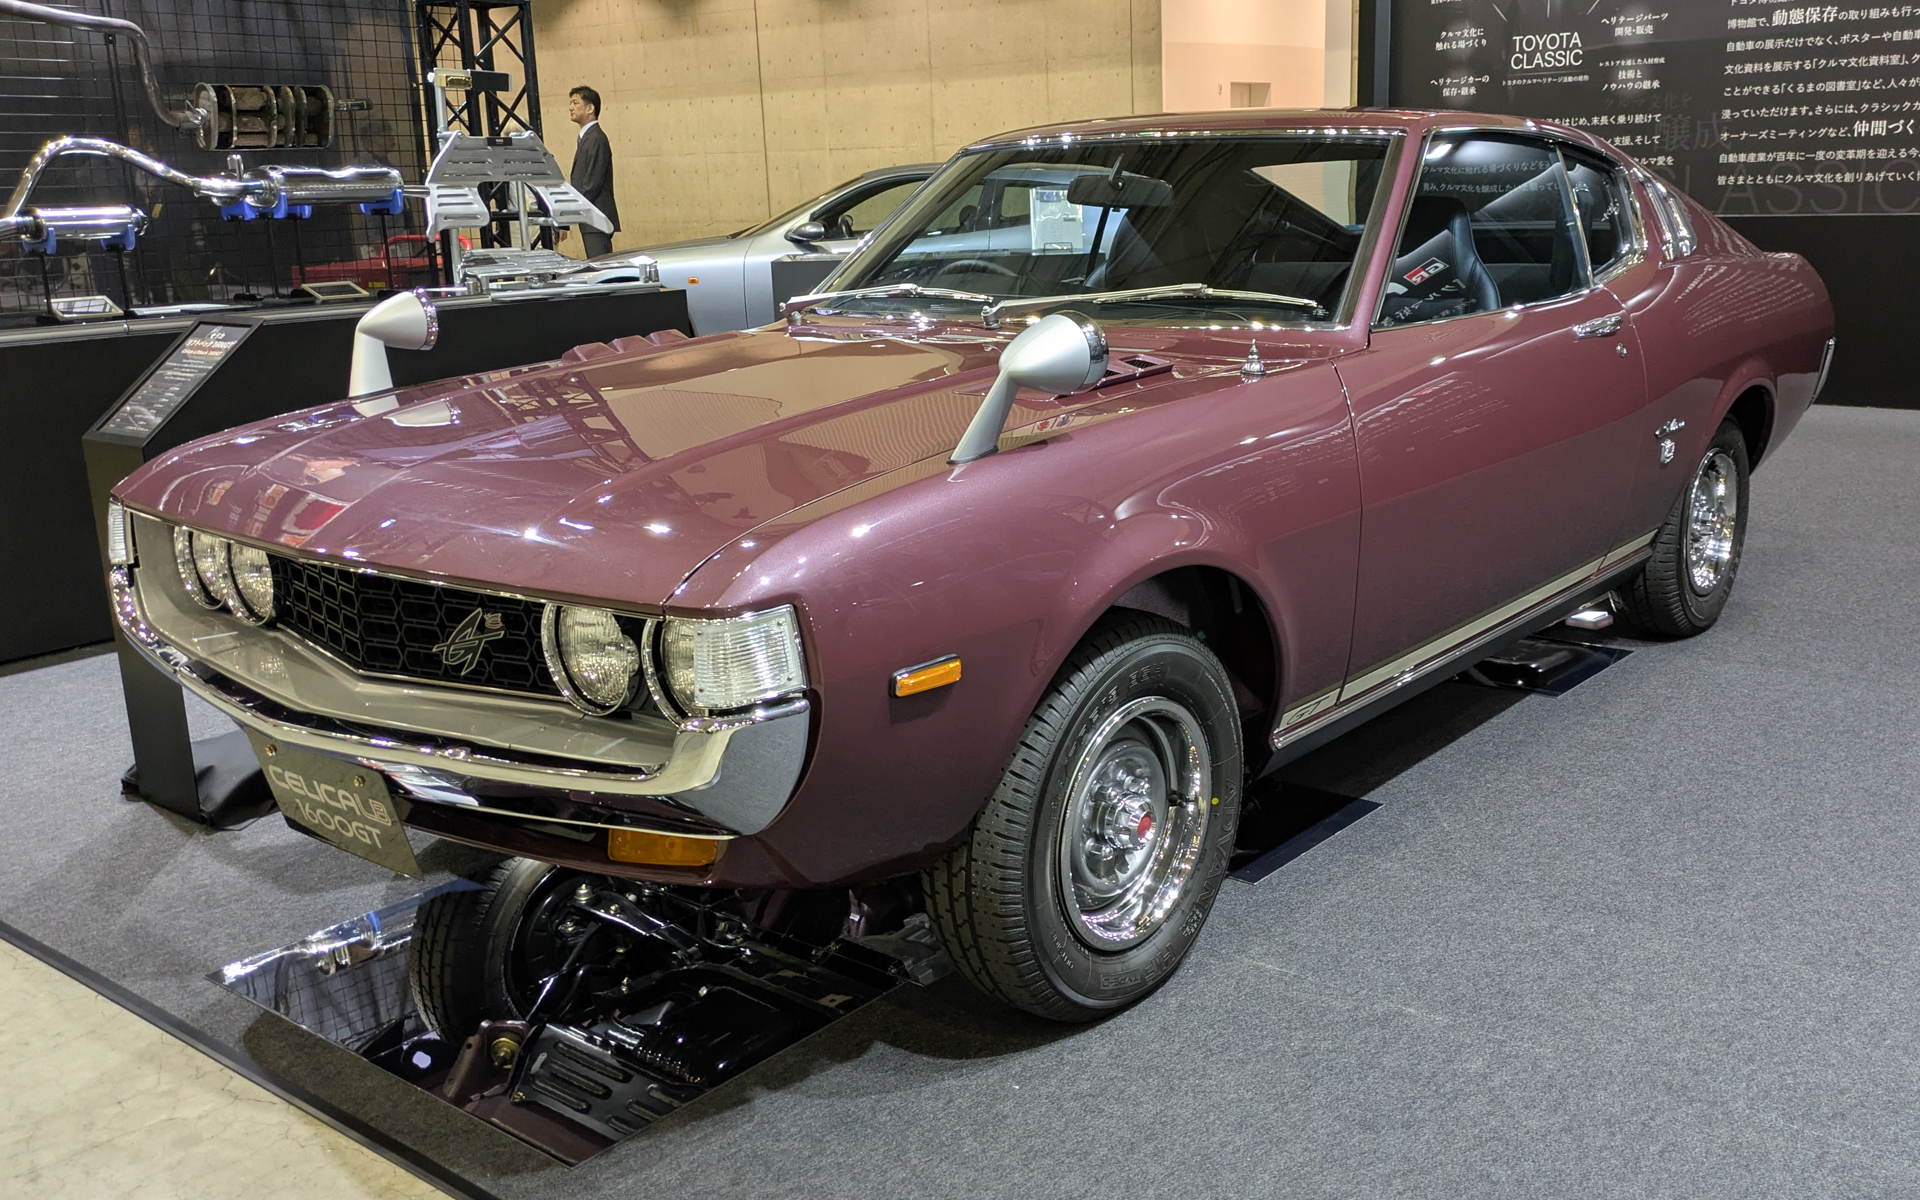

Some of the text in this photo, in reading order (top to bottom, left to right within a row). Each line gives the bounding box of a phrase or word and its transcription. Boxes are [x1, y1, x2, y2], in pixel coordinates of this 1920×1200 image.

[1600, 12, 1669, 26] ヘリテージパーツ
[1440, 27, 1484, 38] クルマ文化に
[1512, 32, 1582, 52] TOYOTA
[1435, 38, 1488, 51] 触れる場づくり
[1510, 50, 1584, 70] CLASSIC
[1430, 74, 1490, 86] ヘリテージカーの
[1286, 694, 1331, 725] GT
[295, 798, 383, 849] 1600GT
[1194, 777, 1238, 915] ADVAN
